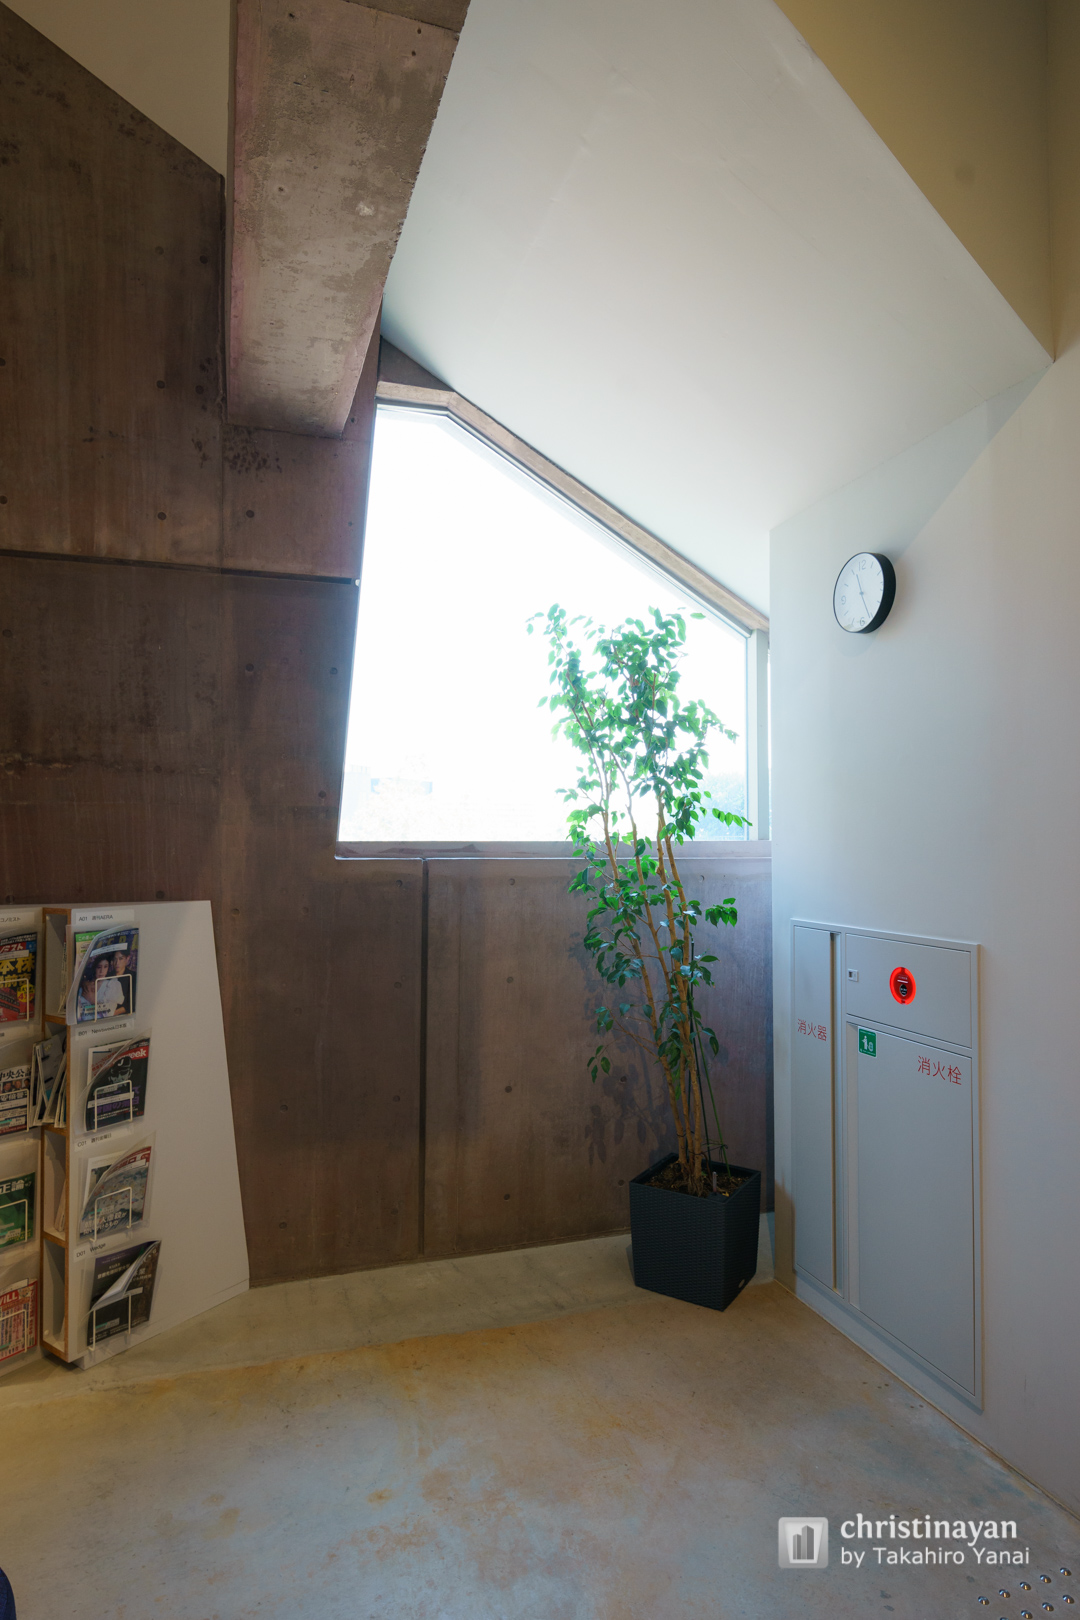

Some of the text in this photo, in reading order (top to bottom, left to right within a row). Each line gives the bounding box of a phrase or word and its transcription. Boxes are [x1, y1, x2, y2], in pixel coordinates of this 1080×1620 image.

[797, 1018, 827, 1042] 消火器
[917, 1055, 962, 1086] 消火栓
